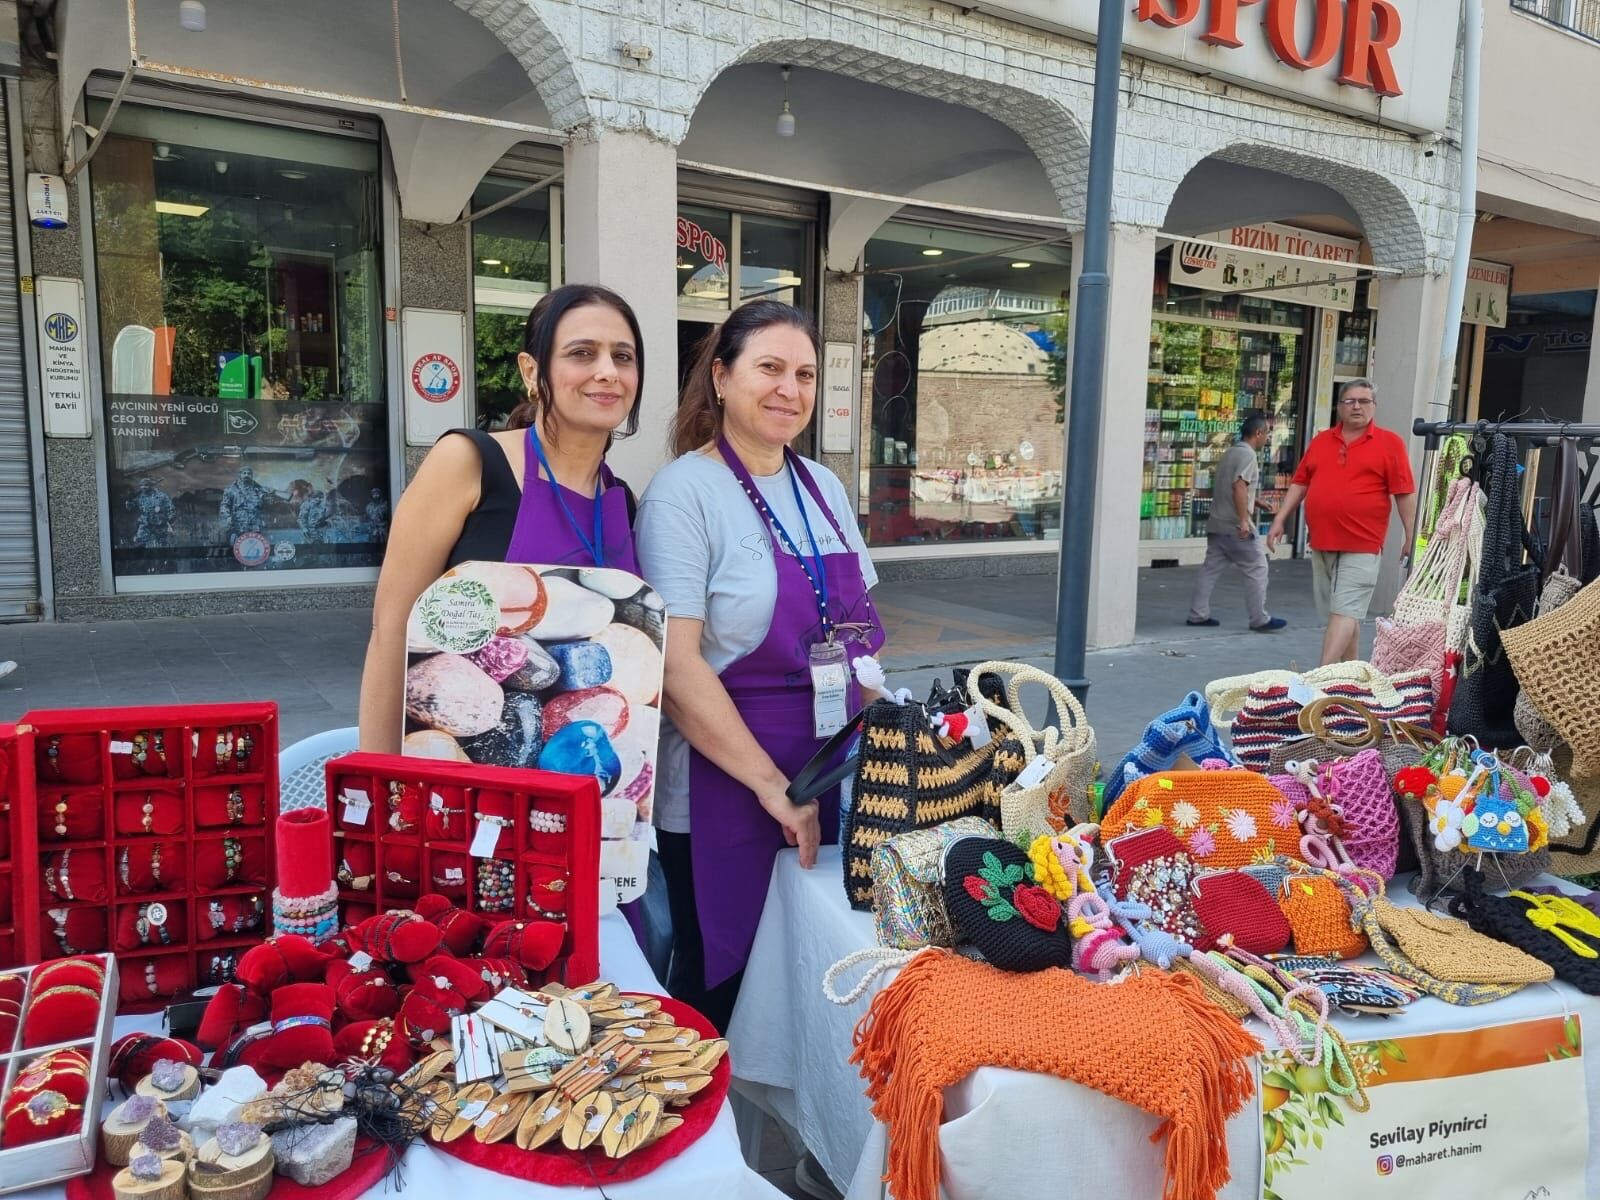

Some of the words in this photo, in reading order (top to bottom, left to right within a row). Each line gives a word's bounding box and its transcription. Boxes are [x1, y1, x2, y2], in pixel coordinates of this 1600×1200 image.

[1138, 0, 1403, 96] OR
[677, 217, 727, 274] SPOR
[1286, 232, 1355, 263] TİCARET
[47, 315, 76, 340] MKE
[1543, 329, 1591, 347] TİC
[828, 357, 850, 369] JET
[49, 391, 81, 400] YETKİLİ
[110, 401, 158, 411] AVCININ
[160, 403, 185, 412] YENİ
[187, 402, 219, 413] GÜCÜ
[836, 408, 850, 417] GB
[111, 415, 136, 424] CEO
[138, 416, 170, 425] TRUST
[172, 414, 188, 425] İLE
[447, 598, 476, 607] Samira
[614, 876, 637, 888] ENE
[1369, 1126, 1425, 1149] Sevilay
[1428, 1113, 1488, 1139] Piynirci
[1395, 1142, 1482, 1168] @maharet.hanim
